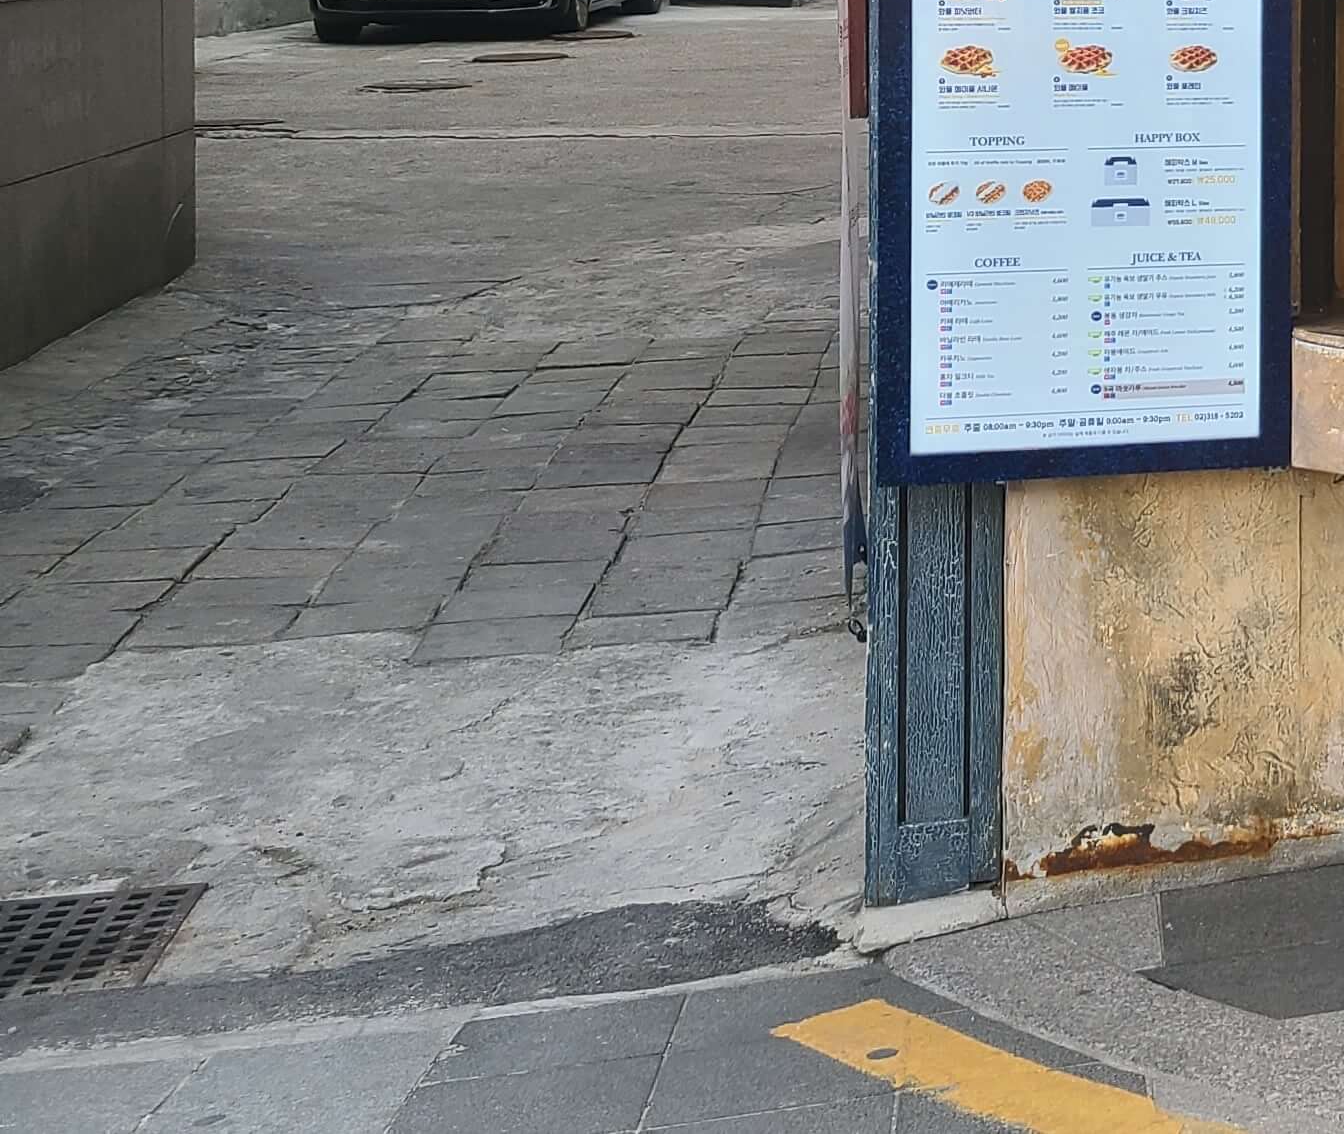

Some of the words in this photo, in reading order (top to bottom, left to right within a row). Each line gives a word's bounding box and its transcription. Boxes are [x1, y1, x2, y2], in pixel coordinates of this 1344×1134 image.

[968, 136, 1025, 147] TOPPING
[1134, 133, 1172, 144] HAPPY
[1175, 132, 1201, 143] BOX
[975, 257, 1021, 268] COFFEE
[1131, 252, 1167, 265] JUICE
[1167, 253, 1178, 262] &
[1179, 251, 1201, 262] TEA
